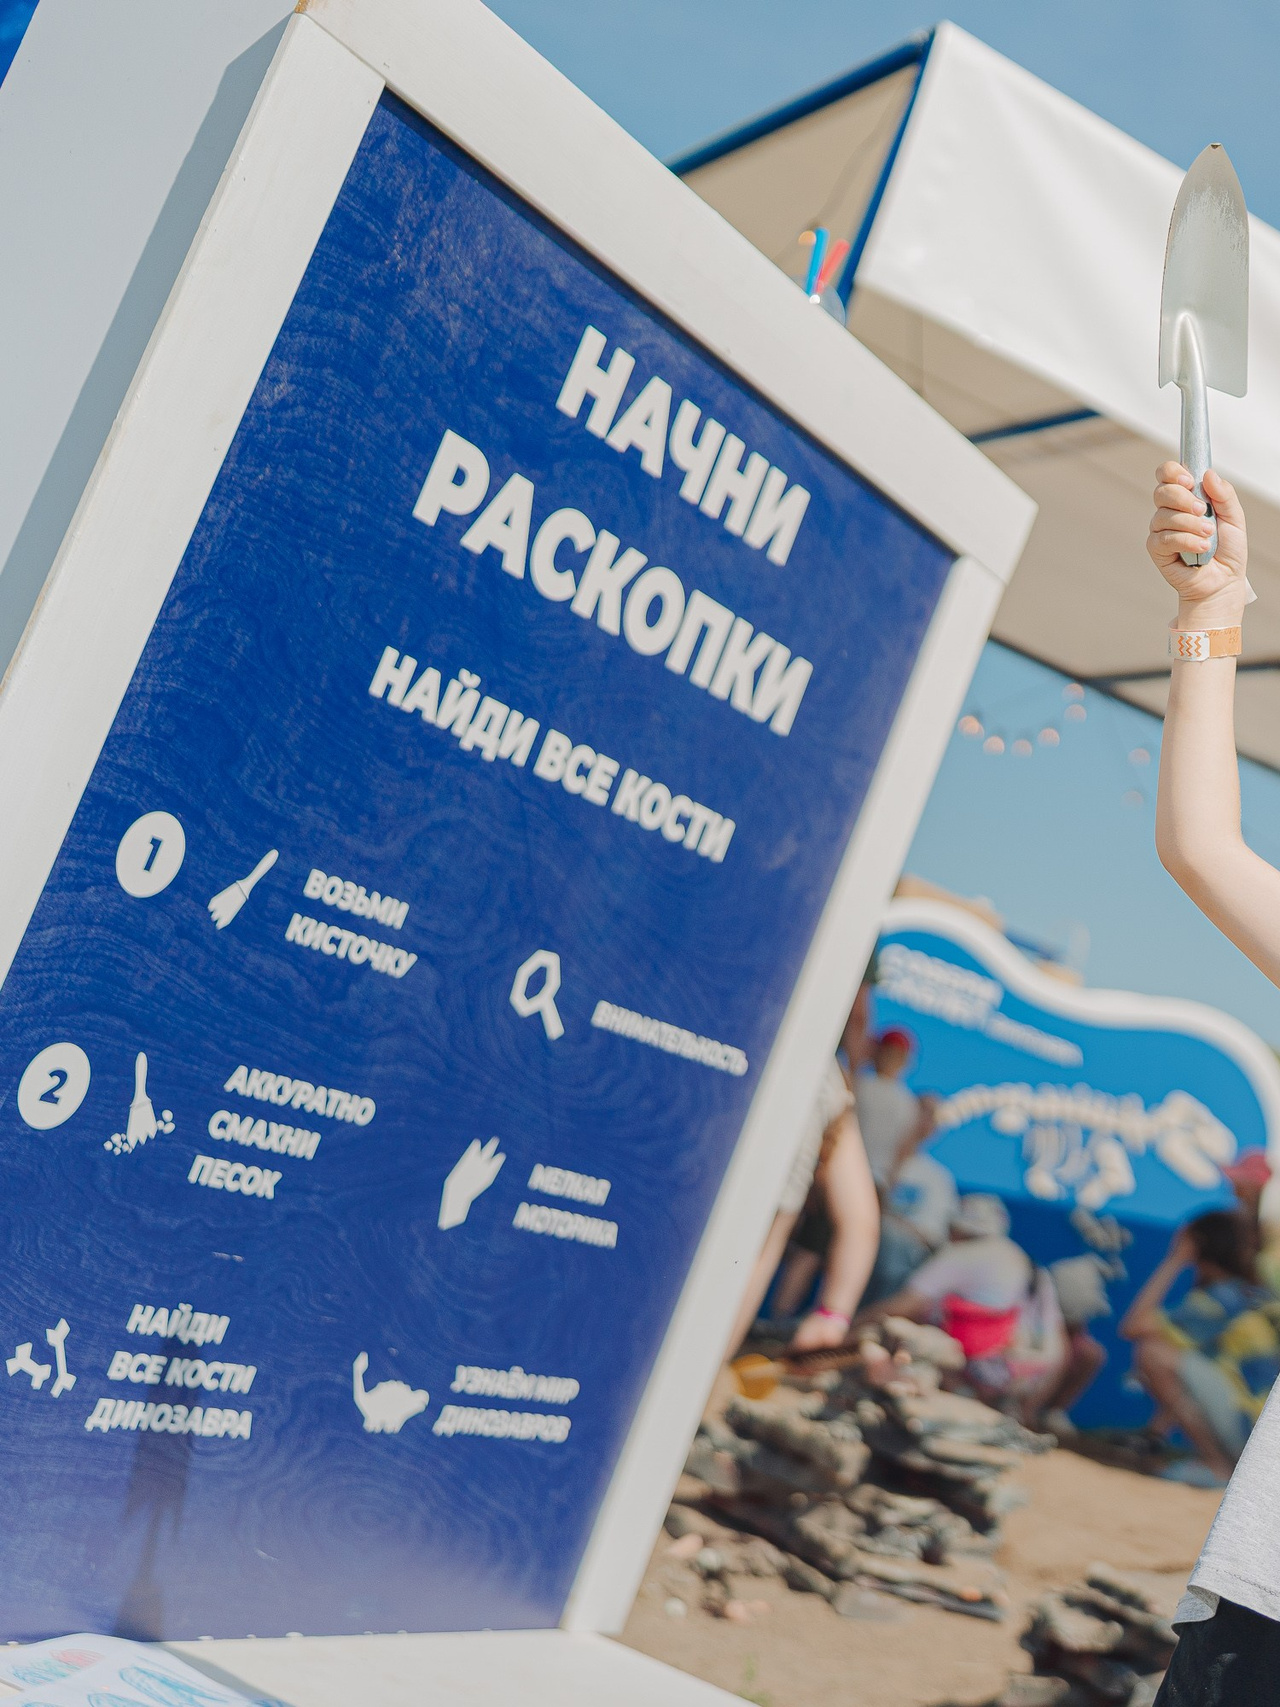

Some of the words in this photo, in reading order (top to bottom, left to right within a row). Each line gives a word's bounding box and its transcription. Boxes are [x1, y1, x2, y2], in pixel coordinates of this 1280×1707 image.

[557, 326, 810, 565] НАЧНИ
[413, 429, 813, 735] РАСКОПКИ
[369, 646, 539, 766] НАЙДИ
[534, 730, 619, 805] ВСЕ
[612, 769, 735, 861] КОСТИ
[144, 836, 163, 873] 1
[304, 869, 409, 928] ВОЗЬМИ
[286, 914, 417, 977] КИСТОЧКУ
[39, 1068, 69, 1105] 2
[224, 1066, 375, 1125] АККУРАТНО
[209, 1111, 320, 1159] СМАХНИ
[188, 1155, 282, 1198] ПЕСОК
[126, 1303, 229, 1345] НАЙДИ
[107, 1351, 166, 1383] ВСЕ
[166, 1358, 256, 1393] КОСТИ
[85, 1398, 252, 1439] ДИНОЗАВРА
